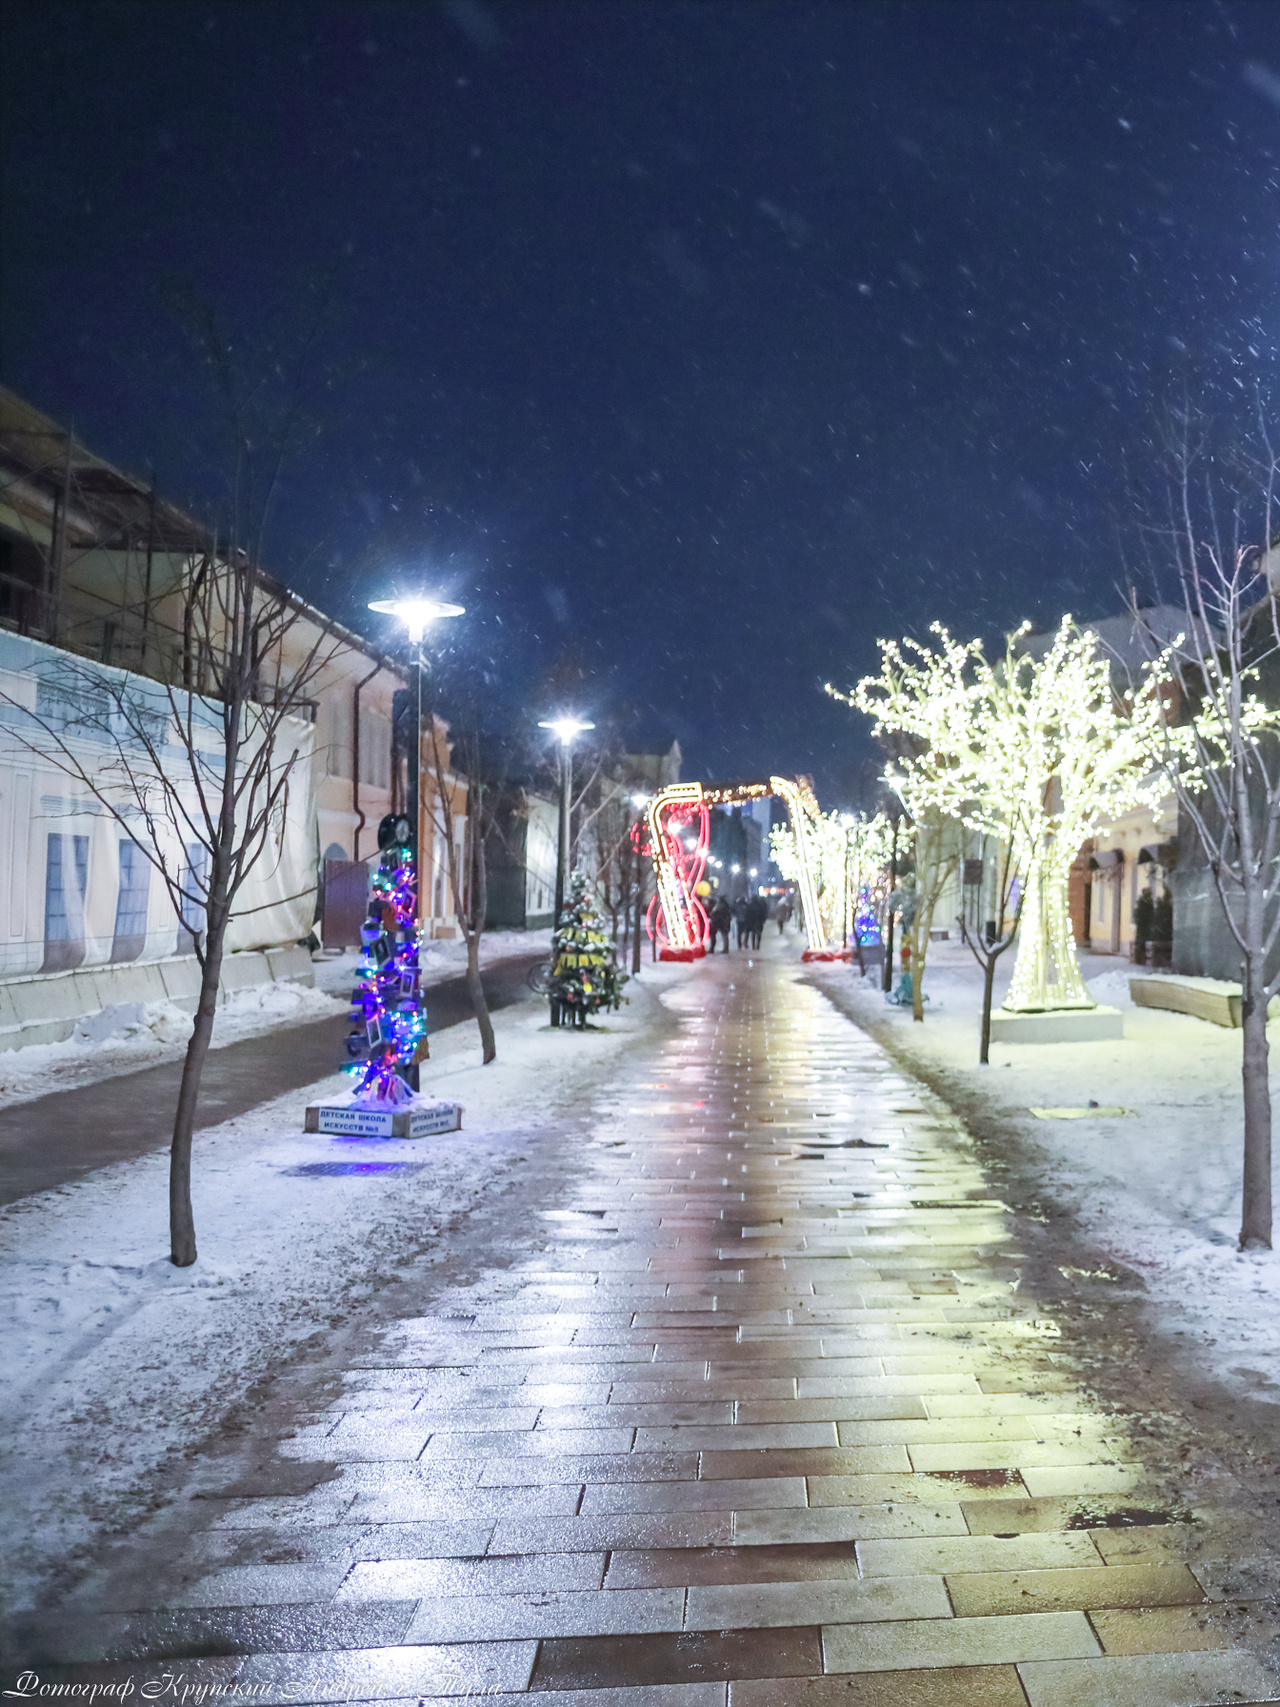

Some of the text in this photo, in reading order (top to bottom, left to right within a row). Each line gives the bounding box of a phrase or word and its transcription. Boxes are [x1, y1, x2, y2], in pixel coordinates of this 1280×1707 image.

[320, 1111, 387, 1123] ДЕТСКАЯ ШКОЛА
[324, 1121, 364, 1131] ИСКУССТВ
